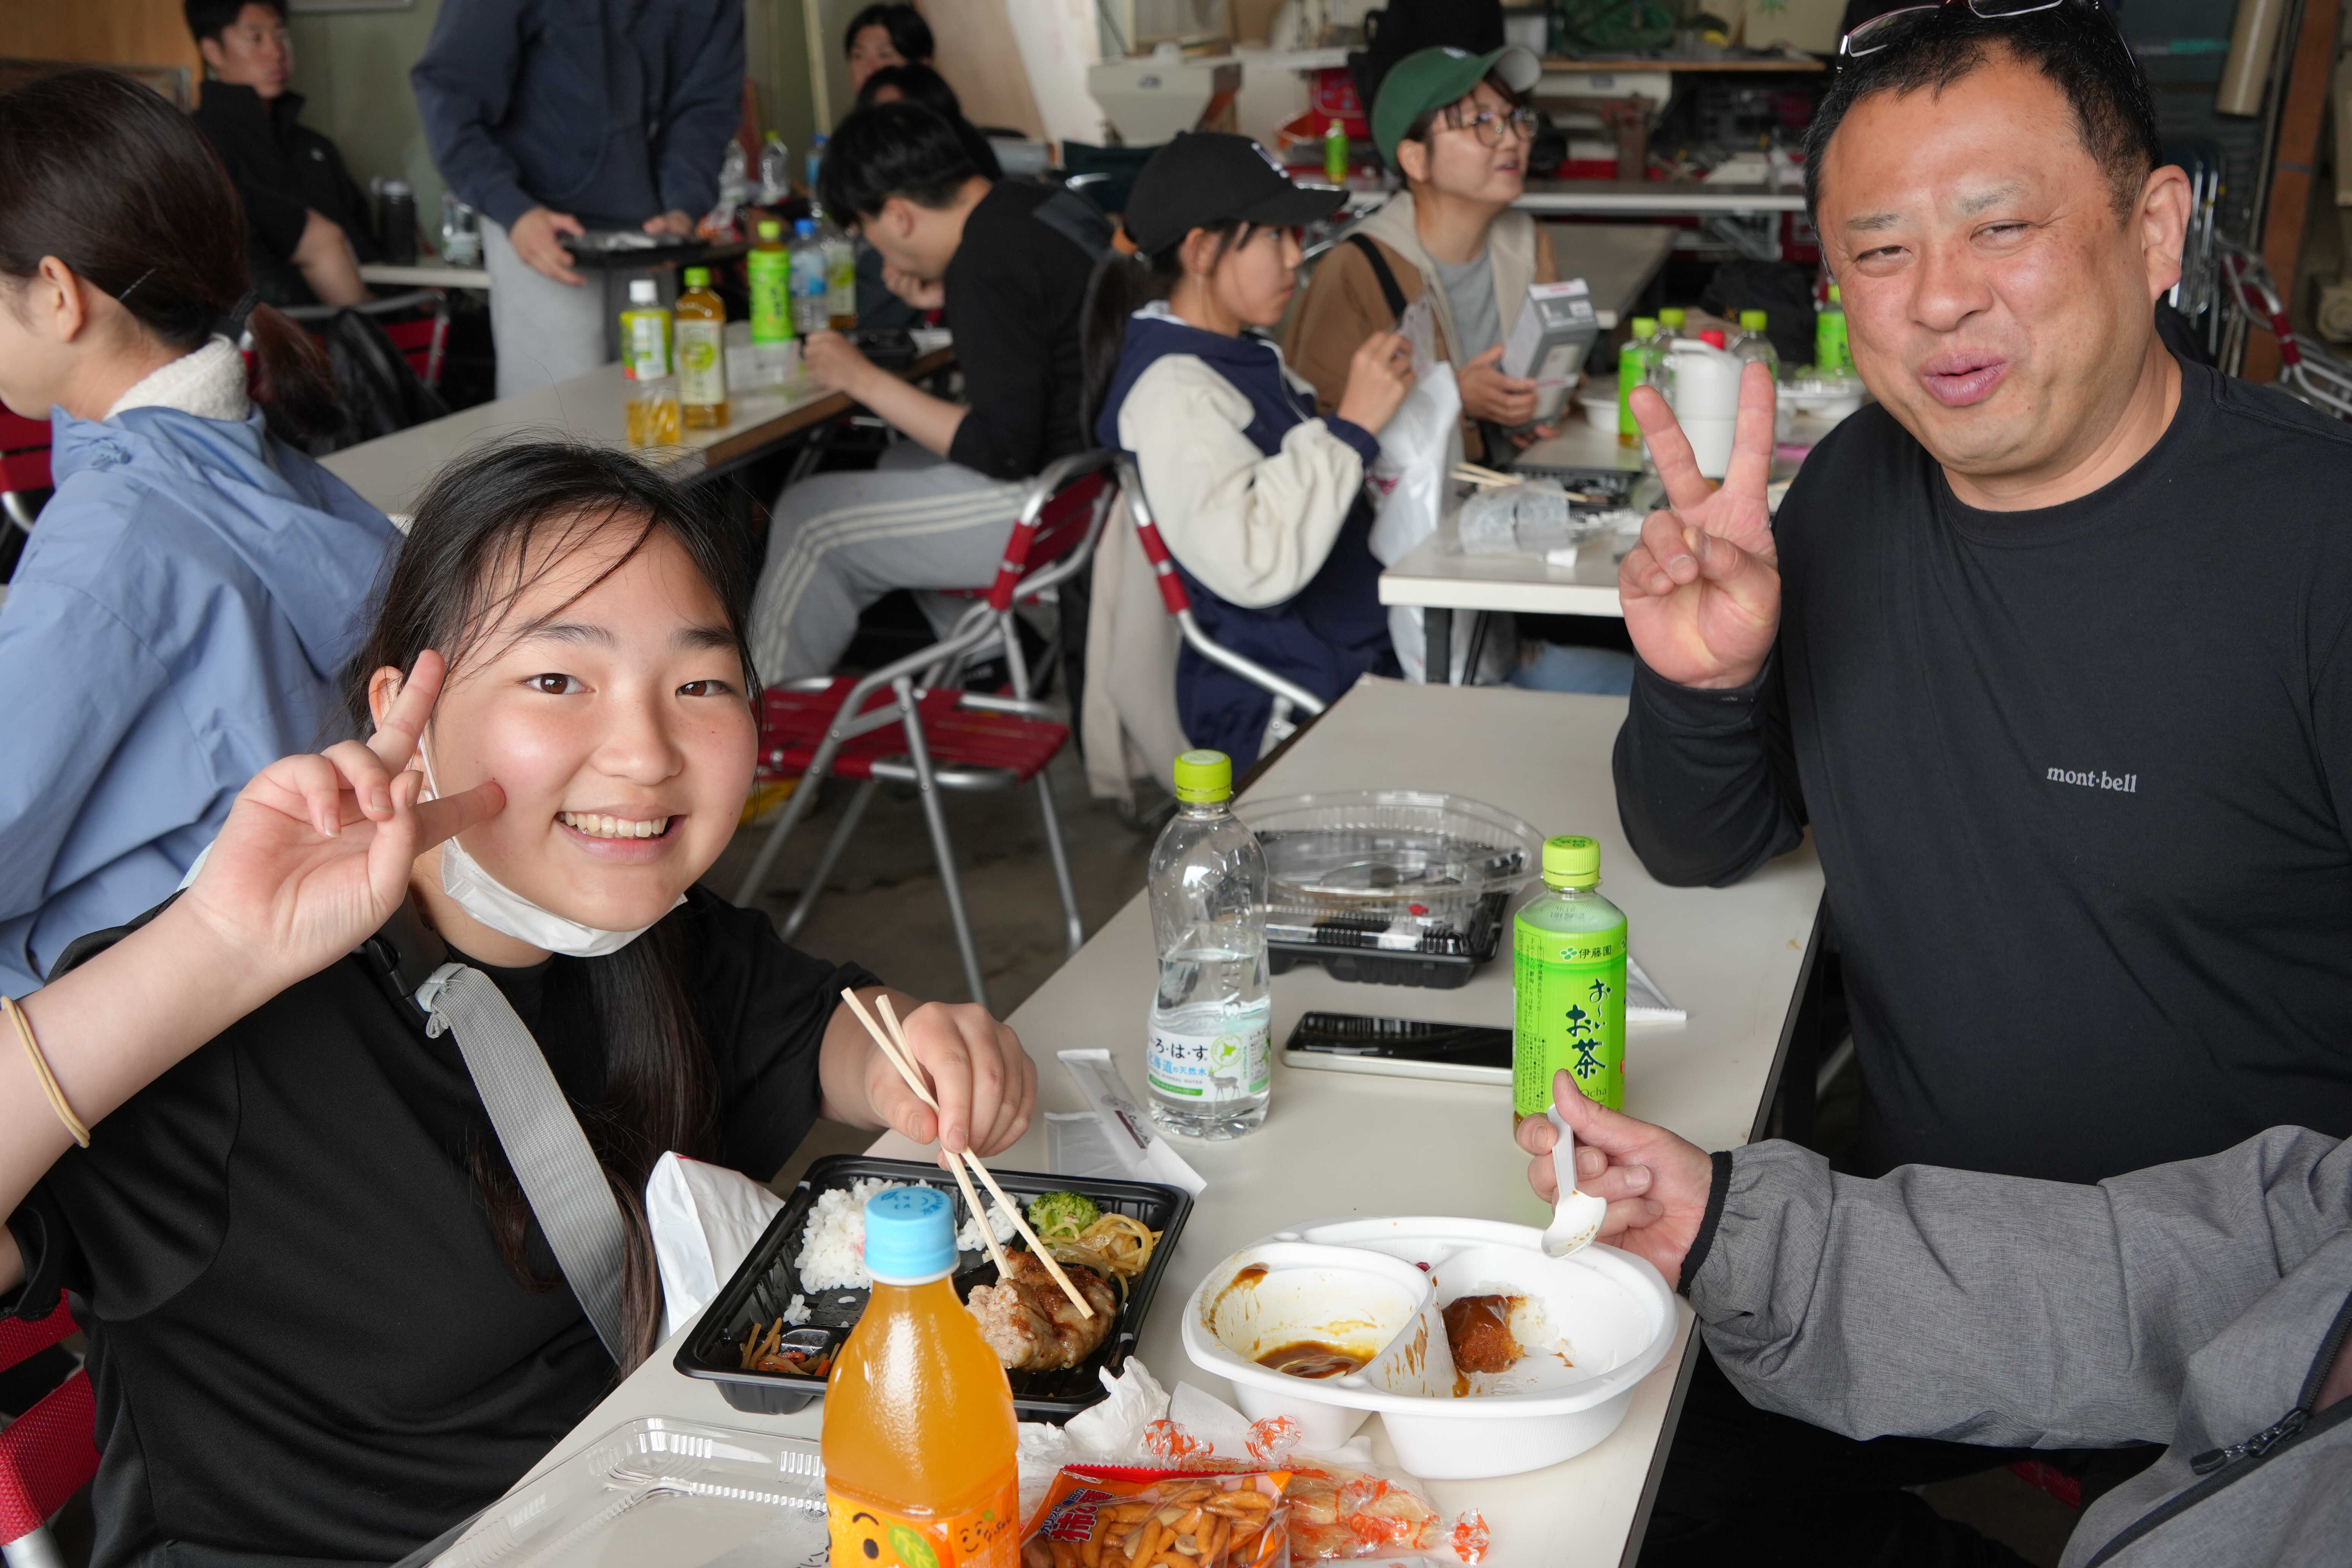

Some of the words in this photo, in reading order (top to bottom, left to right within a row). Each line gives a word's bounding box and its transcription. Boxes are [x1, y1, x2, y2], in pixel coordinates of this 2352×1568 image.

[1579, 945, 1612, 959] 伊藤園
[1565, 1004, 1607, 1079] お茶
